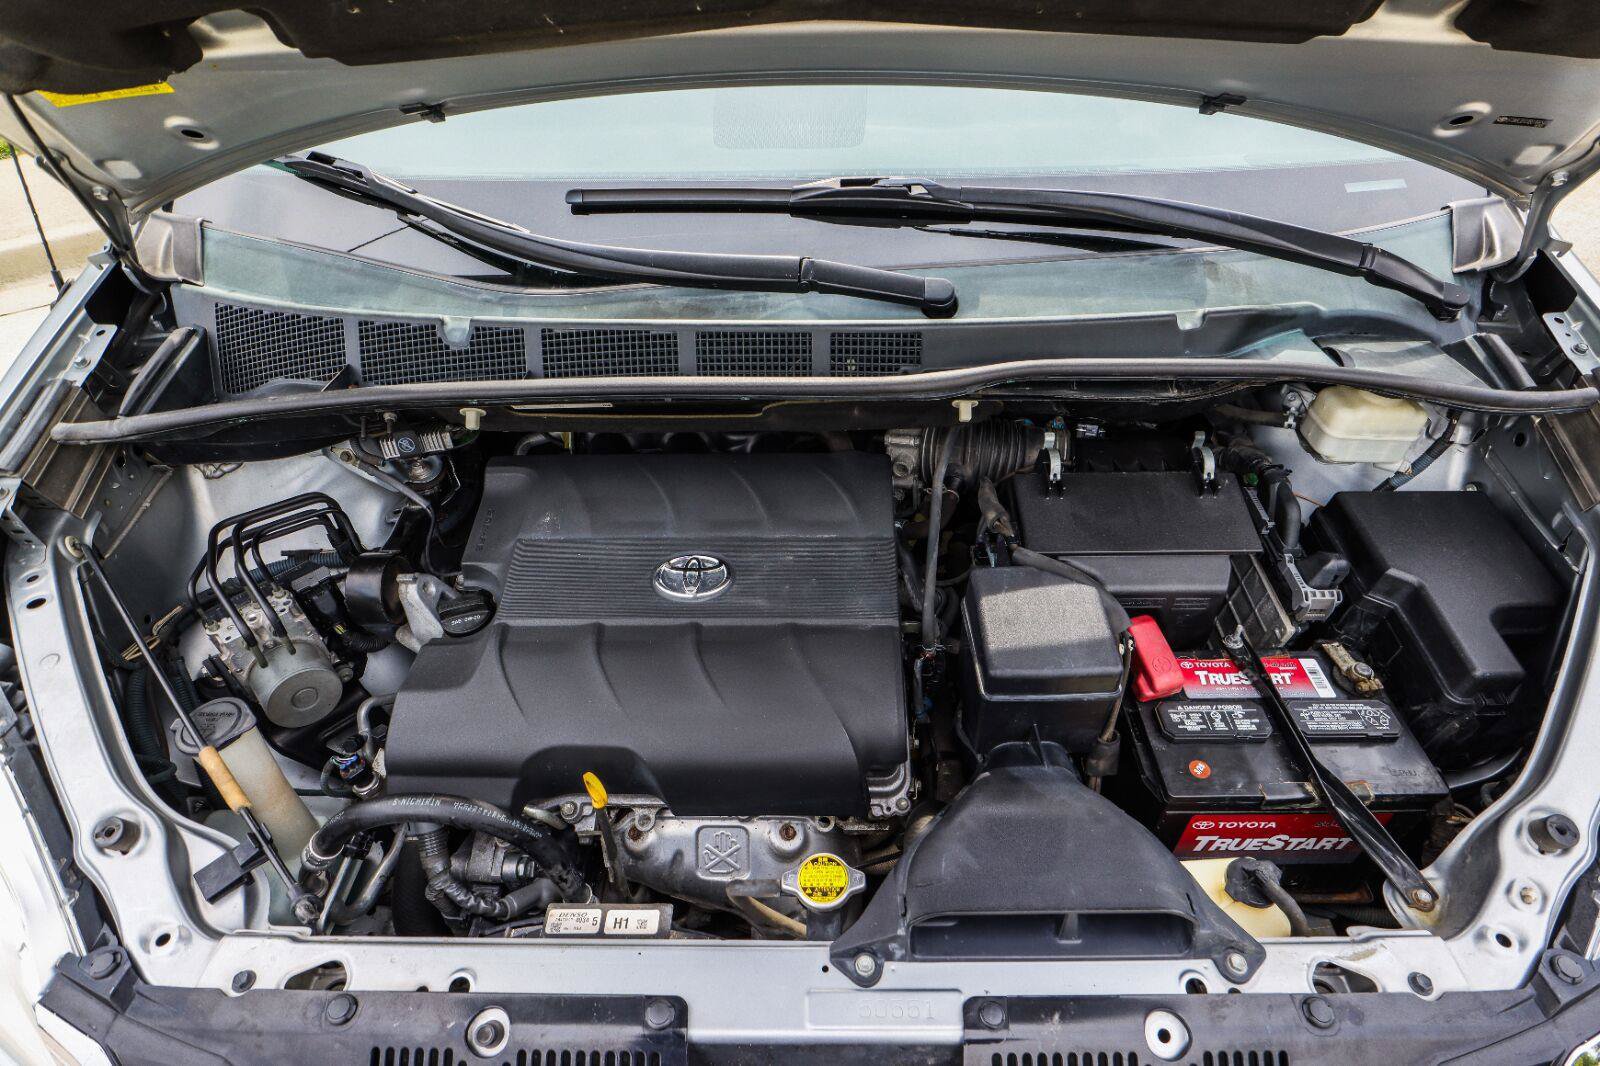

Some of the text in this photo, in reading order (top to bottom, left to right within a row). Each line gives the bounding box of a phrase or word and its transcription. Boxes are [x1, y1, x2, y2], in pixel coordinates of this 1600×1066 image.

[1218, 821, 1276, 829] TOYOTA
[592, 916, 598, 926] 5
[613, 917, 629, 929] H1
